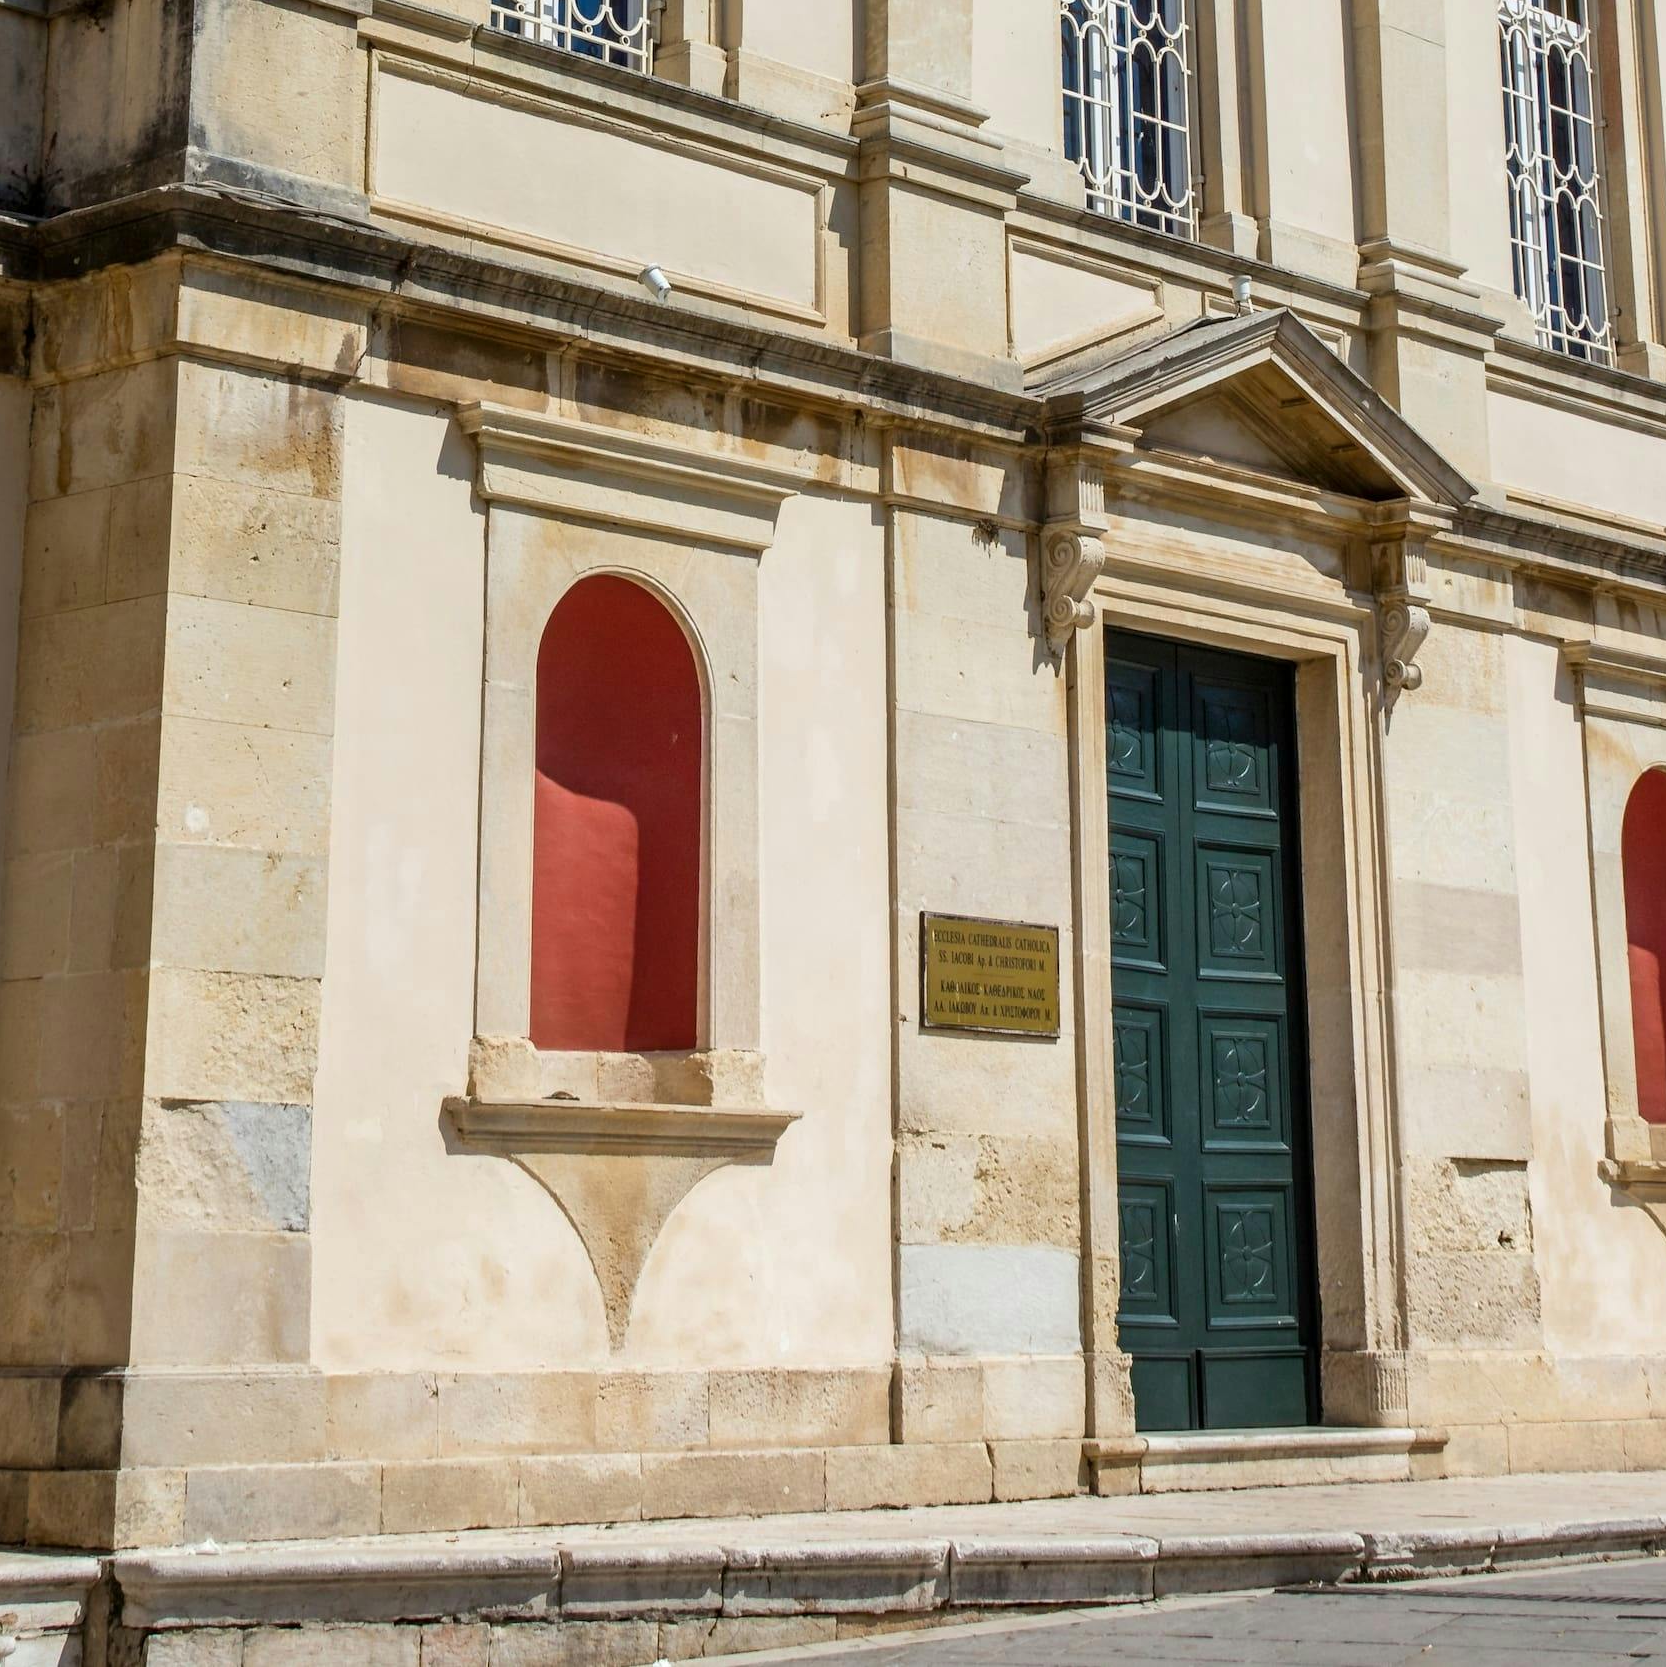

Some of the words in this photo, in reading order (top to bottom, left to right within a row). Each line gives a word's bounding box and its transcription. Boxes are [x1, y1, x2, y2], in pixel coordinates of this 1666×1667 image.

[934, 930, 965, 944] ECCLESIA
[968, 932, 1012, 949] CATHEDRALIS
[1015, 937, 1050, 953] CATHOLICA
[939, 950, 948, 962] SS.
[951, 951, 973, 966] IACOBI
[995, 956, 1037, 971] CHRISTOFORI
[983, 983, 1024, 999] ΚΑΘΕΔΡΙΚΟΣ
[1028, 987, 1045, 1001] ΝΑΟΣ
